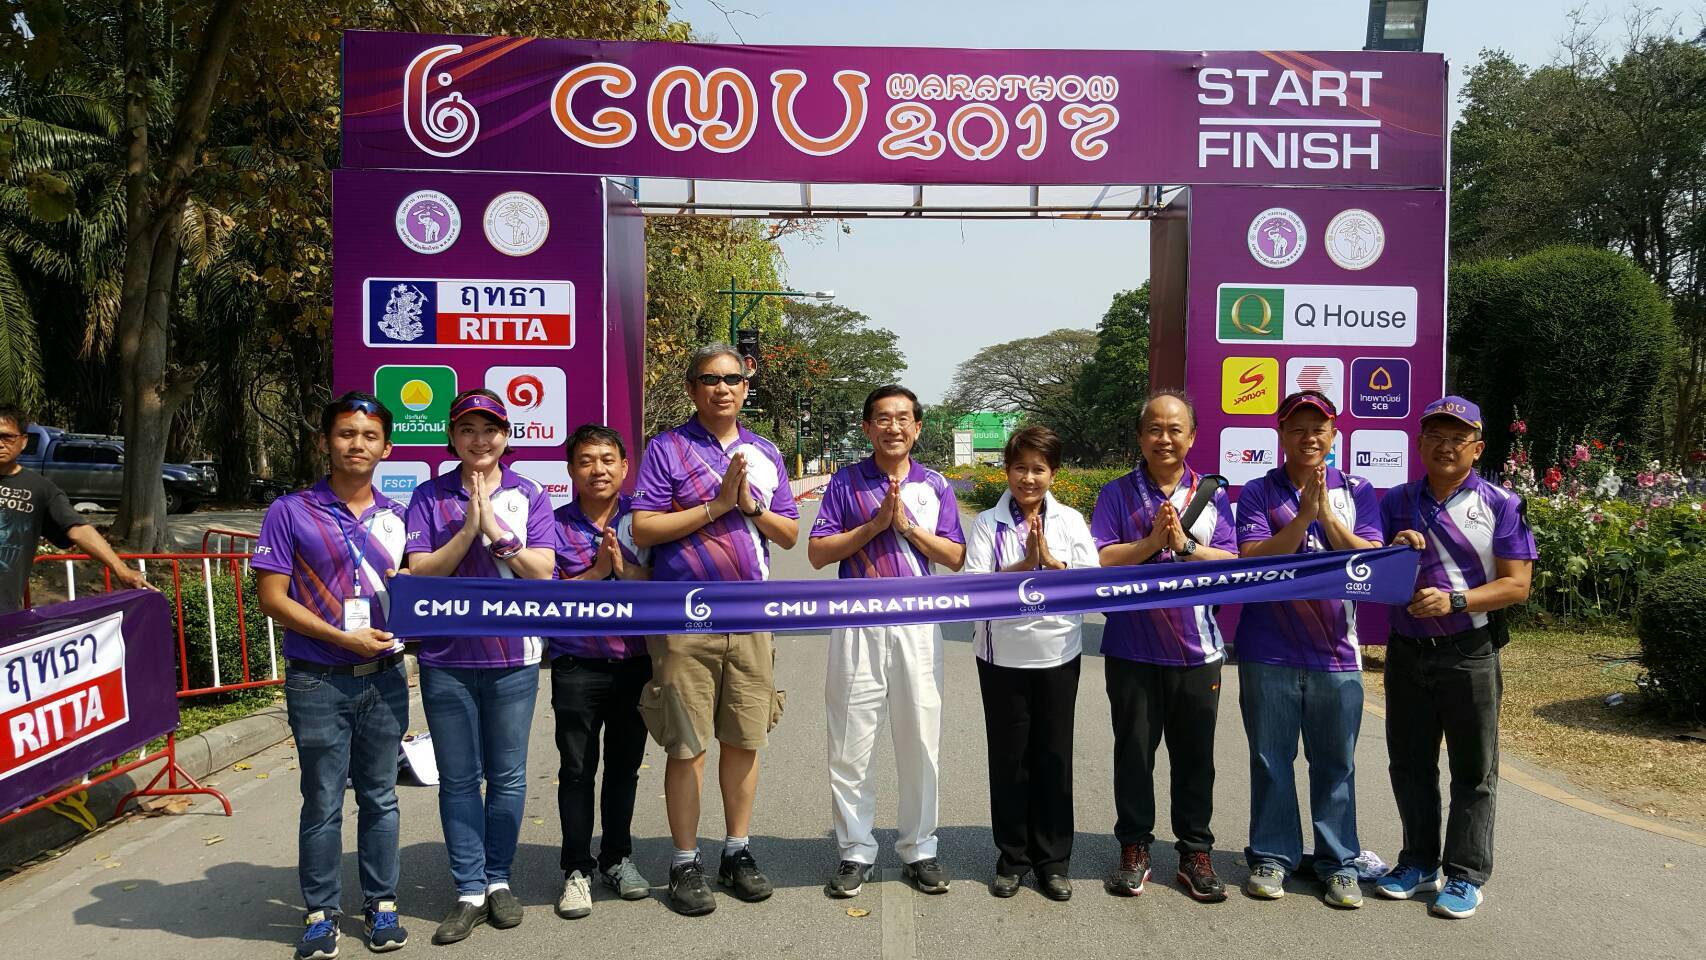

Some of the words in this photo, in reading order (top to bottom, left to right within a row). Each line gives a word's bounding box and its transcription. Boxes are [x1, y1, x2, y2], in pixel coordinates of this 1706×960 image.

[885, 72, 1120, 102] MARATHON
[1197, 67, 1383, 108] START
[877, 101, 1120, 161] 2017
[1198, 130, 1380, 170] FINISH
[460, 281, 547, 312] ฤทธา
[459, 317, 547, 343] RITTA
[1294, 303, 1316, 328] Q
[1323, 304, 1407, 329] House
[393, 419, 446, 432] ทยวิวัฒน์
[508, 421, 554, 439] ชิตัน
[1242, 449, 1272, 461] SMC
[383, 479, 415, 488] FSCT
[1096, 583, 1148, 598] CMU
[1159, 568, 1298, 593] MARATHON
[414, 599, 470, 616] CMU
[482, 600, 633, 618] MARATHON
[764, 601, 817, 617] CMU
[829, 594, 971, 615] MARATHON
[7, 633, 98, 702] ฤทธา
[10, 684, 105, 760] RITTA
